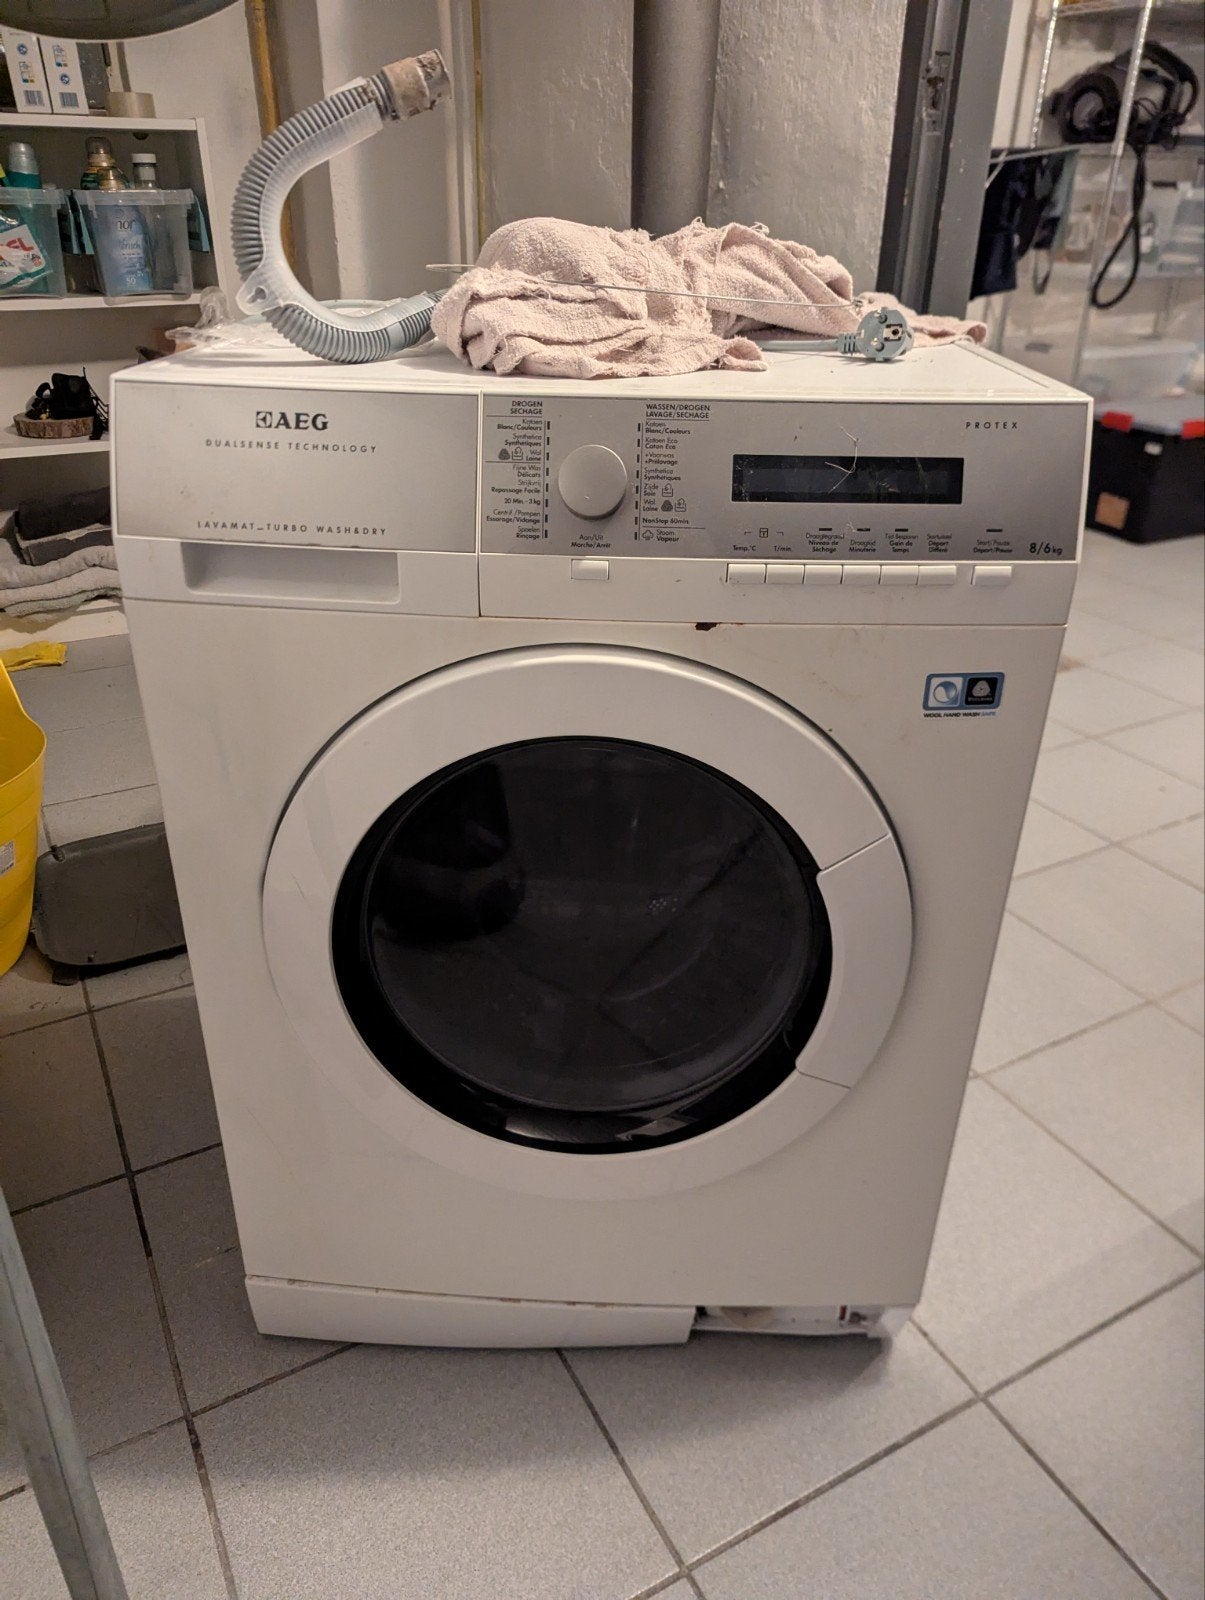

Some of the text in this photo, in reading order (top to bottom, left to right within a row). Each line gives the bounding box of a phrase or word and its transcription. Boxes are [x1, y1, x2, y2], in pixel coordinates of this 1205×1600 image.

[645, 403, 711, 411] WASSEN/DROGEN
[645, 411, 710, 419] LAVAGE/SECHAGE
[274, 412, 329, 431] AEG
[965, 421, 1018, 430] PROTEX
[497, 423, 542, 431] Blanc/Couleurs
[645, 427, 691, 435] Blanc/Couleurs
[205, 438, 377, 453] DUALSENSE TECHNOLOGY
[491, 486, 523, 495] Repassage
[486, 515, 541, 525] Essorage/Vidange
[642, 517, 669, 526] NonStop
[316, 525, 387, 536] WASH&DRY
[656, 535, 680, 543] Vapeur
[1028, 542, 1063, 555] 8/6 kg
